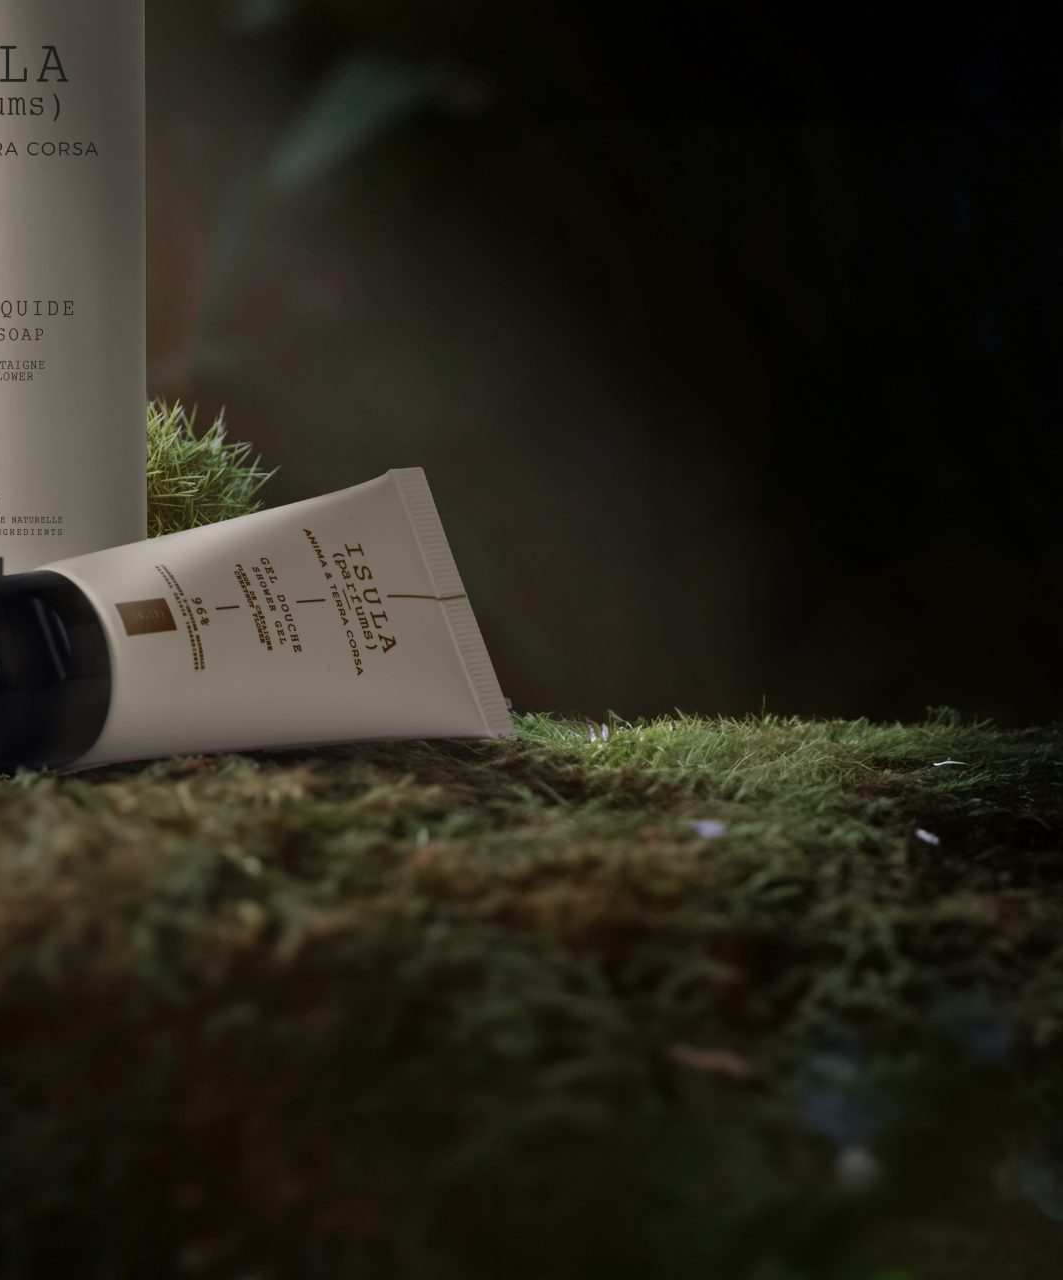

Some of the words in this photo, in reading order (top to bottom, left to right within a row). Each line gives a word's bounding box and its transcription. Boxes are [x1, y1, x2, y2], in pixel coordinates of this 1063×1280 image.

[26, 141, 99, 158] CORSA
[10, 515, 64, 525] NATURELLE
[191, 597, 210, 627] 96%
[252, 566, 277, 612] SHOWER
[274, 620, 287, 645] GEL
[252, 613, 266, 644] FLOWER
[260, 557, 278, 584] GEL
[277, 594, 302, 653] DOUCHE
[302, 528, 328, 568] ANIMA
[324, 571, 333, 580] &
[330, 584, 350, 626] TERRA
[346, 630, 364, 676] CORSA
[333, 553, 378, 650] (parfums)
[344, 544, 397, 654] ISULA
